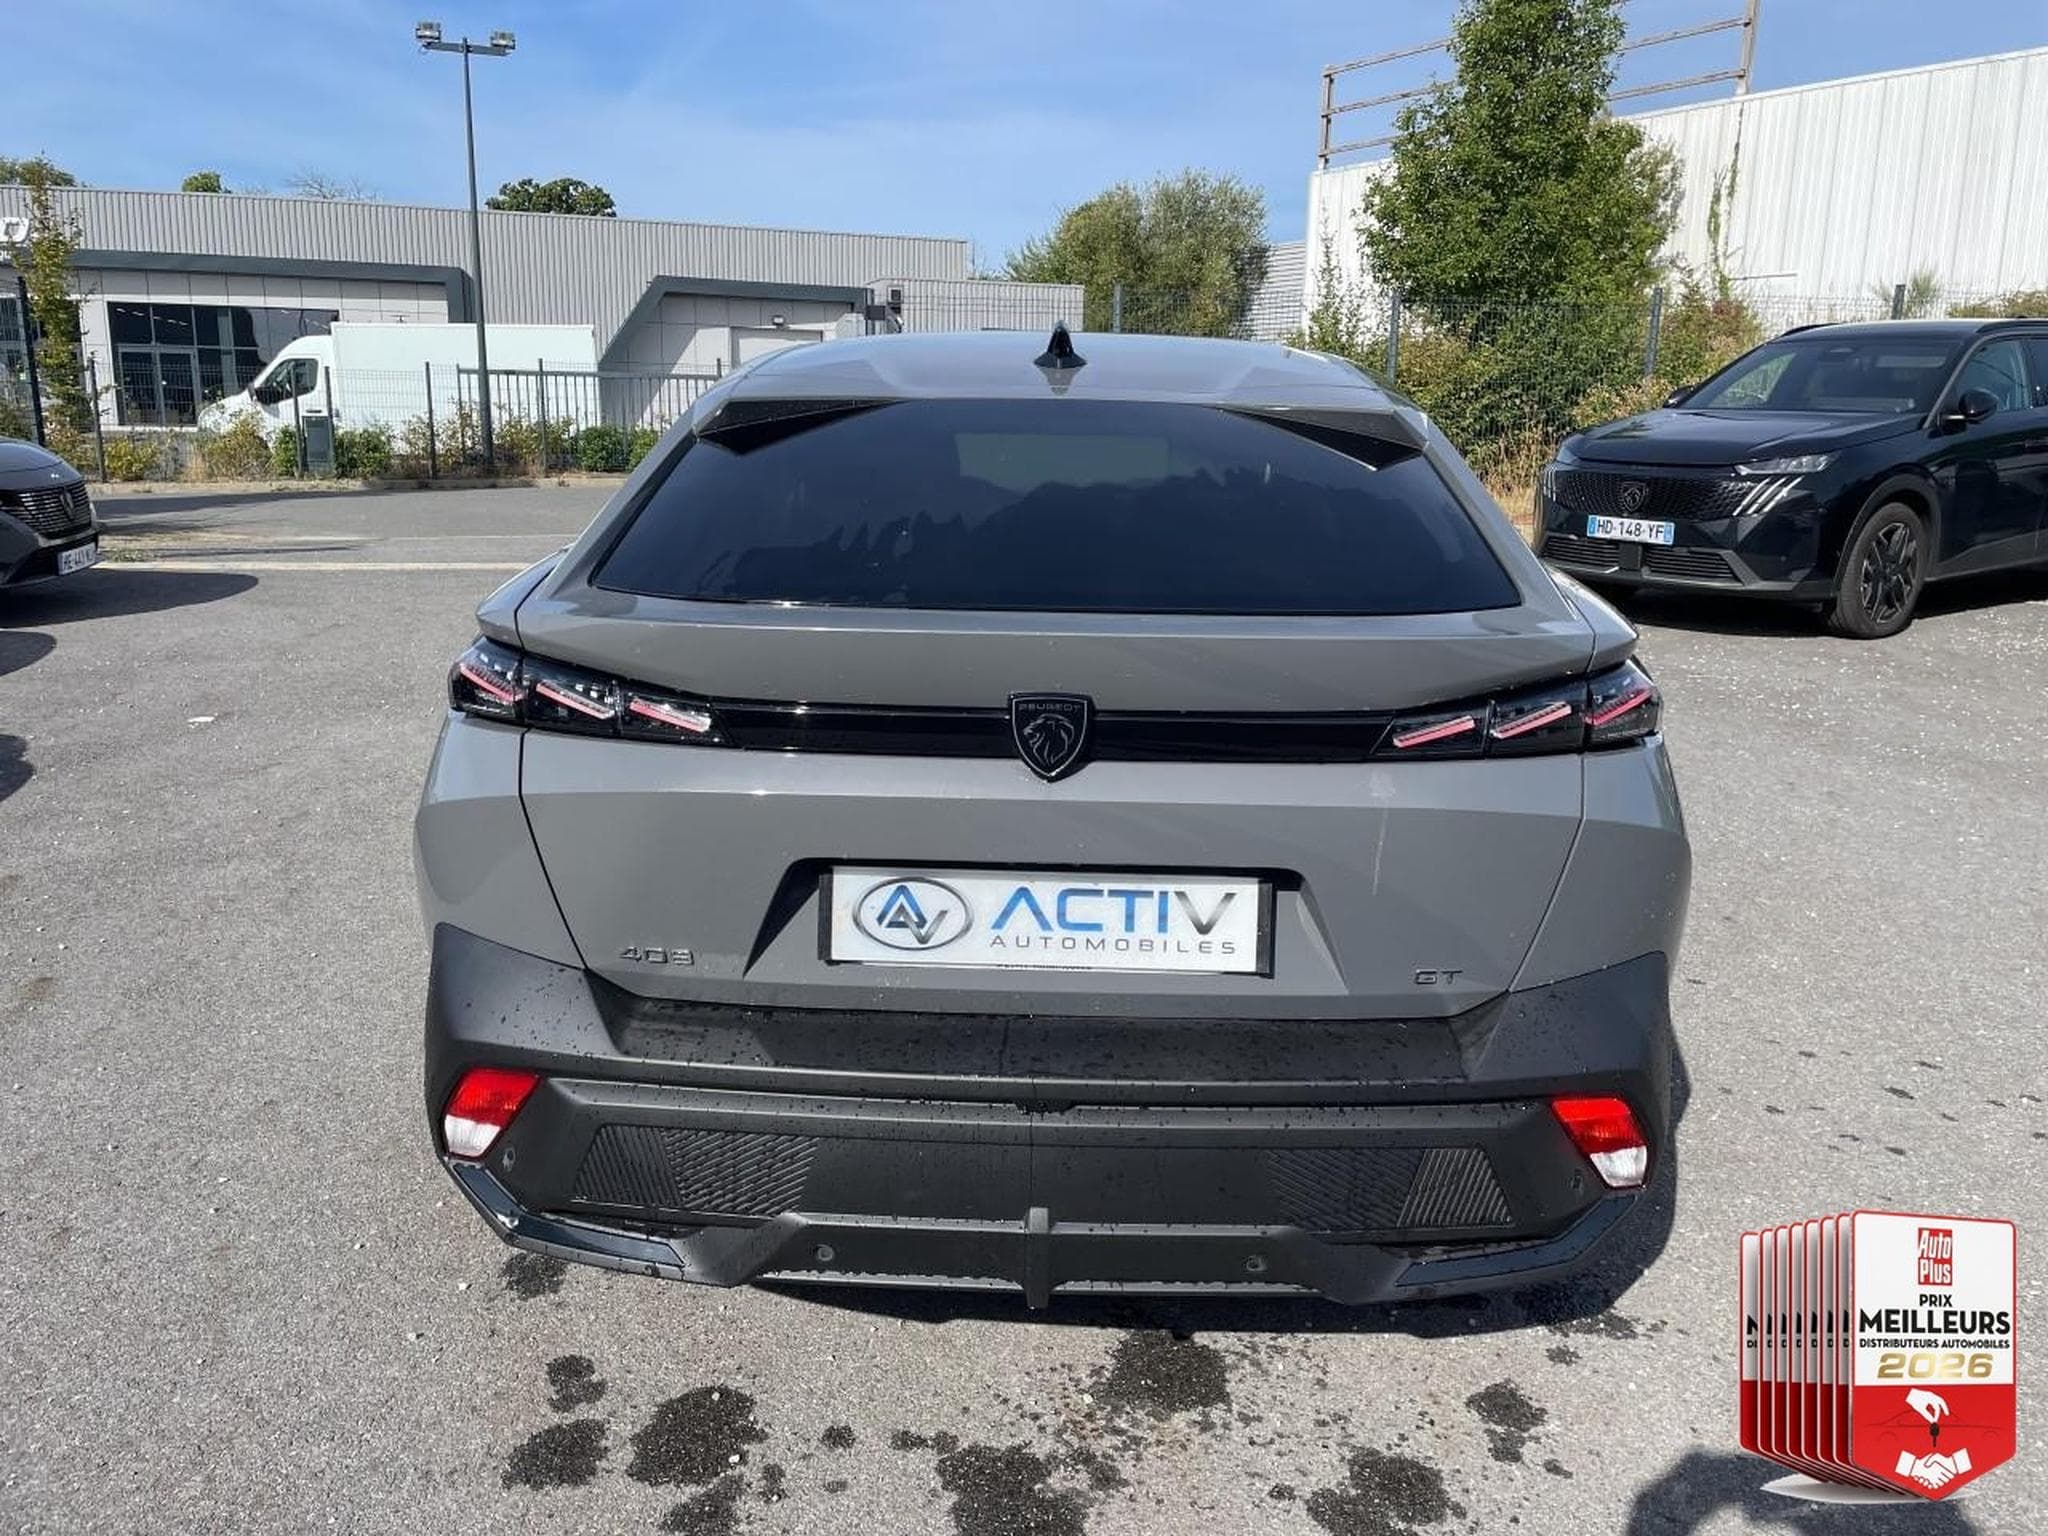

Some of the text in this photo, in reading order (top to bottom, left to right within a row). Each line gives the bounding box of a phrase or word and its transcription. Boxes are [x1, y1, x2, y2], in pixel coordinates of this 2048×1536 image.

[1597, 519, 1665, 538] HD-148-YF
[991, 885, 1237, 935] ACTIV
[989, 936, 1236, 954] AUTOMOBILES
[1414, 968, 1463, 985] GT
